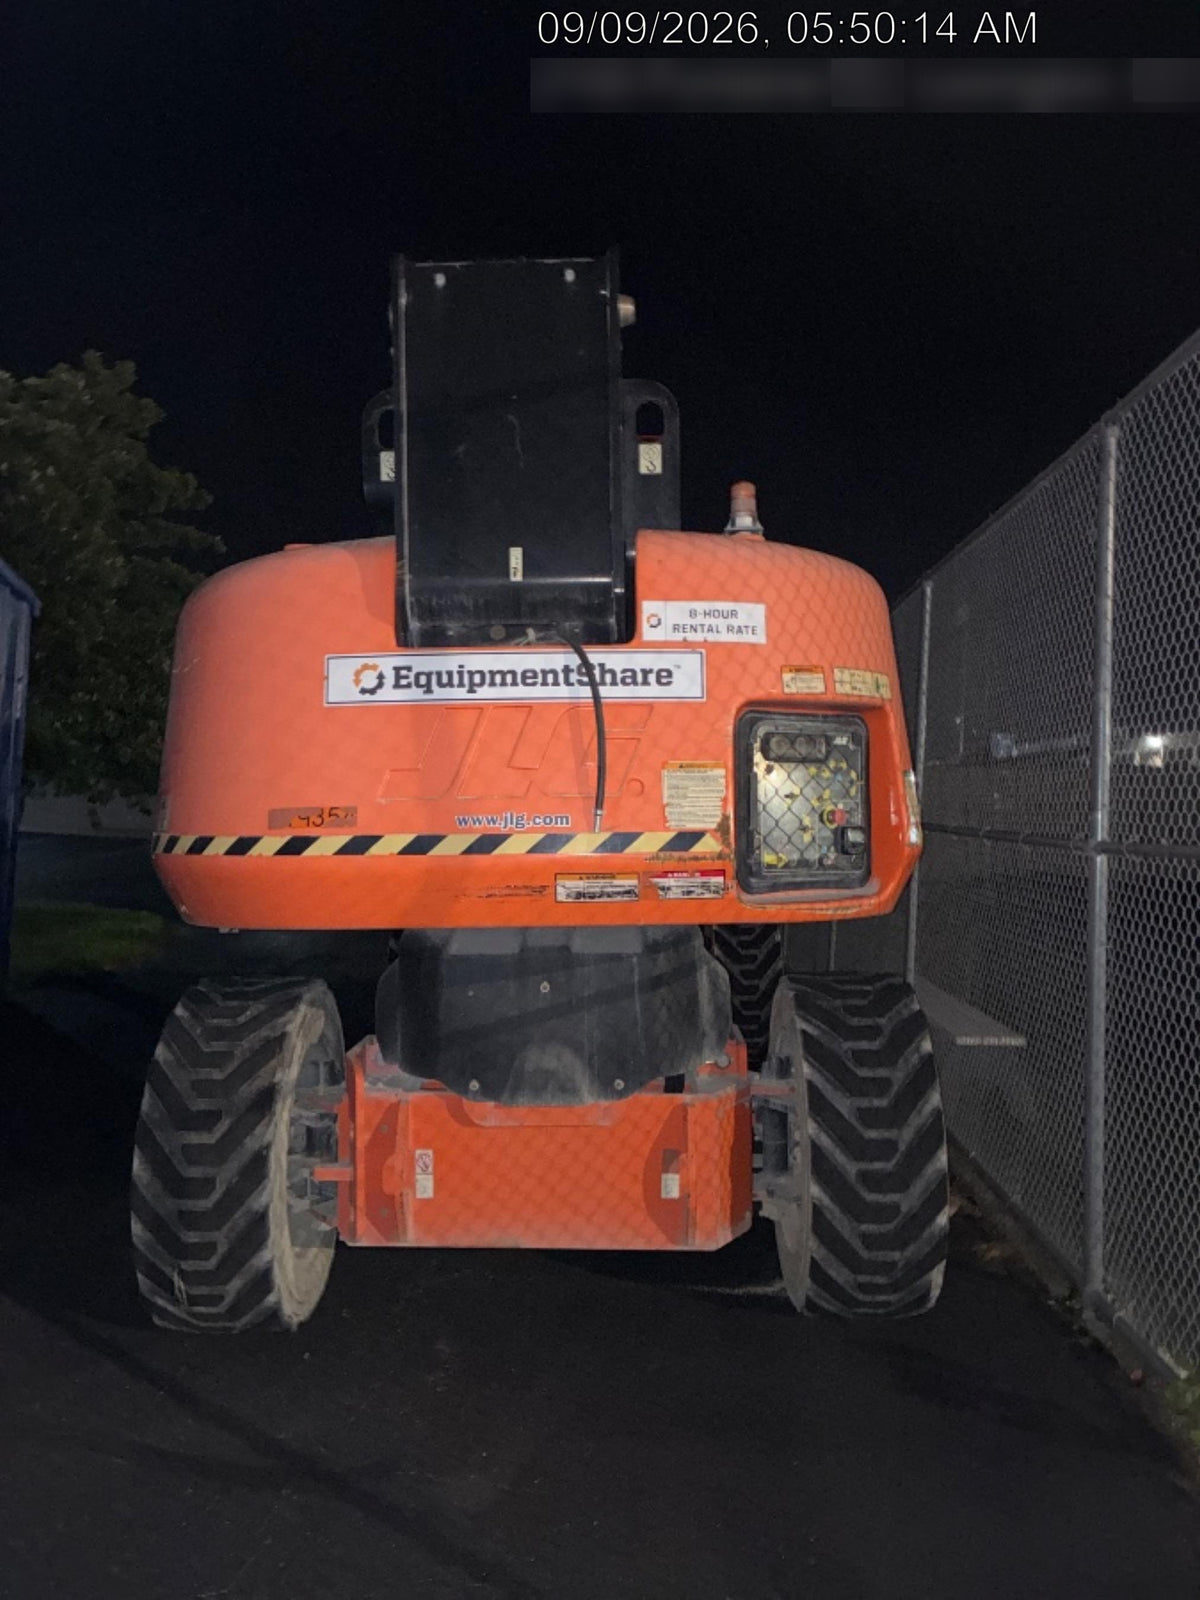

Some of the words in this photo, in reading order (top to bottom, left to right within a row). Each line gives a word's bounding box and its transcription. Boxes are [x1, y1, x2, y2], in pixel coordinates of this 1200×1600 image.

[672, 622, 722, 635] RENTAL
[726, 624, 758, 636] RATE
[392, 662, 674, 694] EquipmentShare
[455, 811, 570, 829] www.jlg.com
